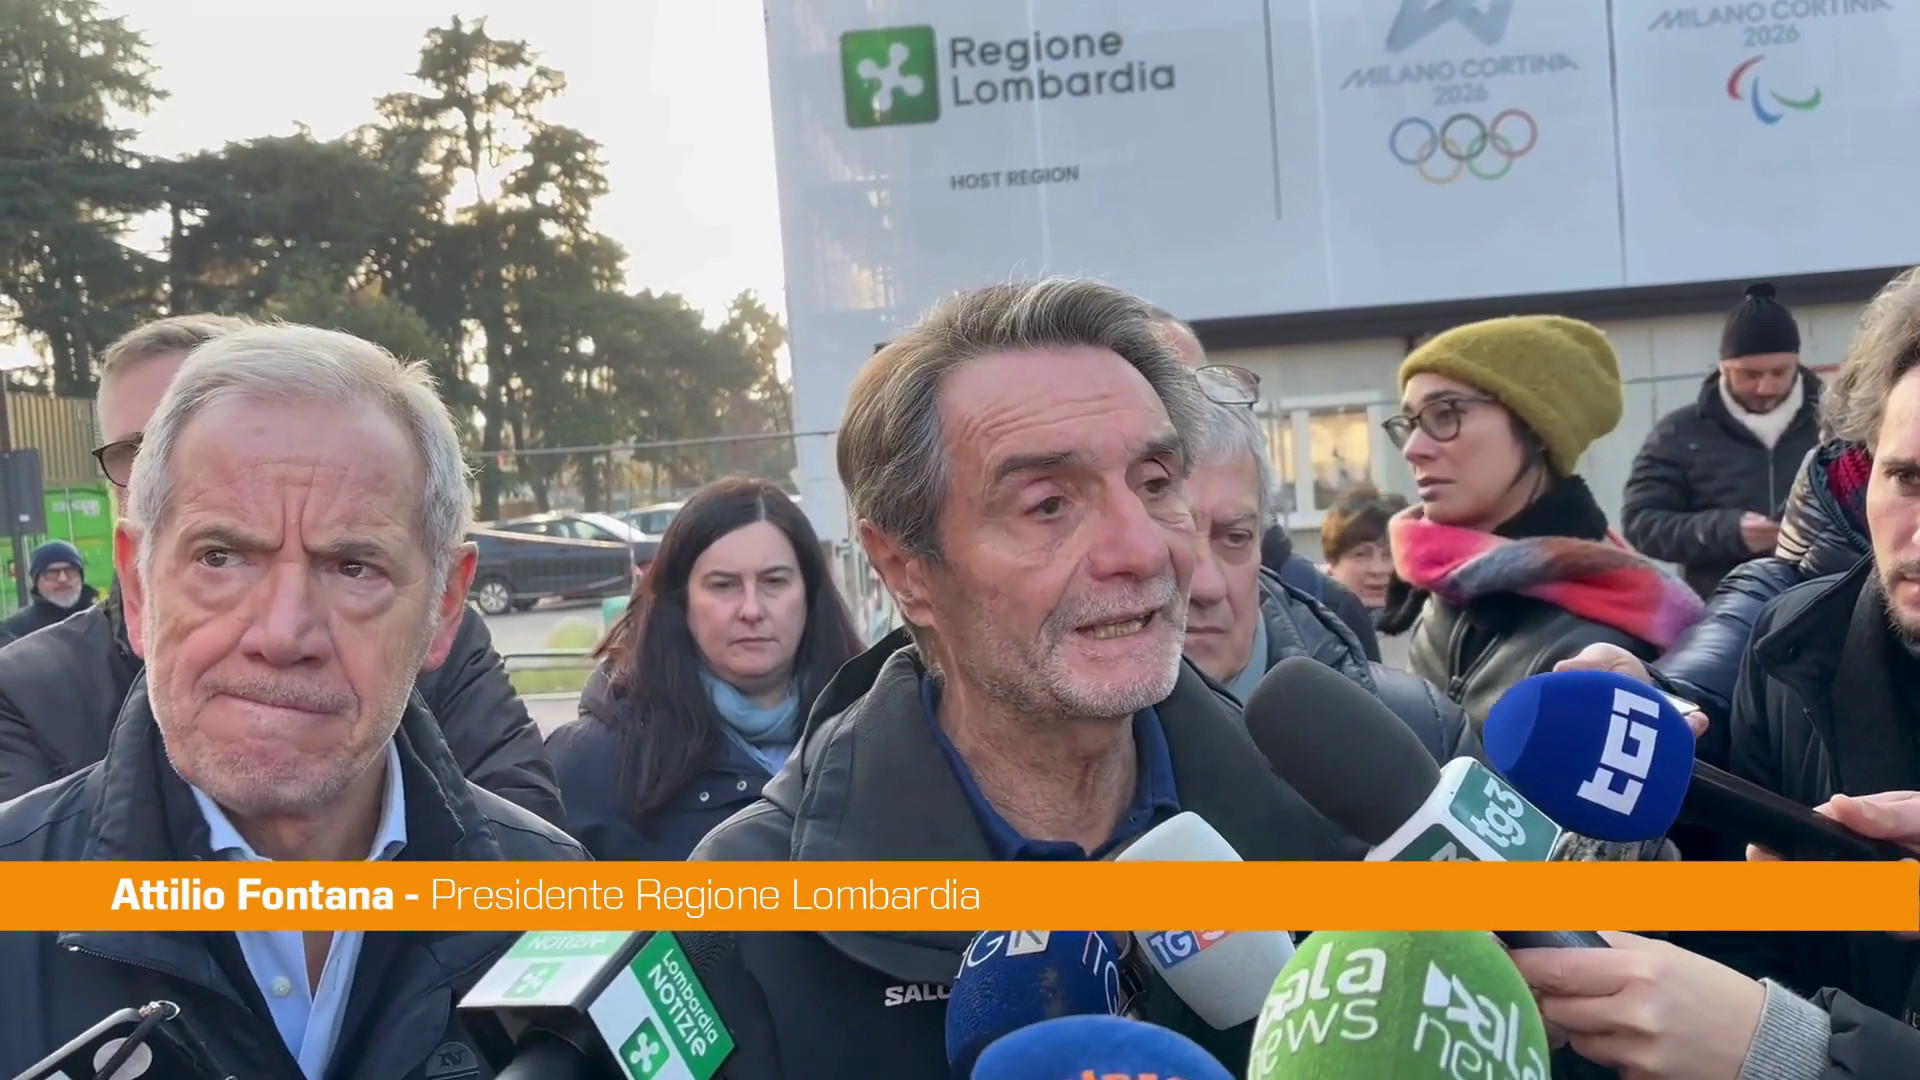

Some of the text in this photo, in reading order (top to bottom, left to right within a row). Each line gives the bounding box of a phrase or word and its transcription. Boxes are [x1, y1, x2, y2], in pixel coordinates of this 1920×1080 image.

[1648, 2, 1767, 31] MILANO
[1744, 23, 1800, 47] 2026
[949, 30, 1124, 71] Regione
[953, 60, 1176, 107] Lombardia
[1340, 53, 1581, 90] MILANO CORTINA
[1433, 82, 1489, 106] 2026
[951, 165, 1080, 191] HOST REGION
[1469, 776, 1527, 848] tg3
[661, 948, 719, 1045] Lombardia
